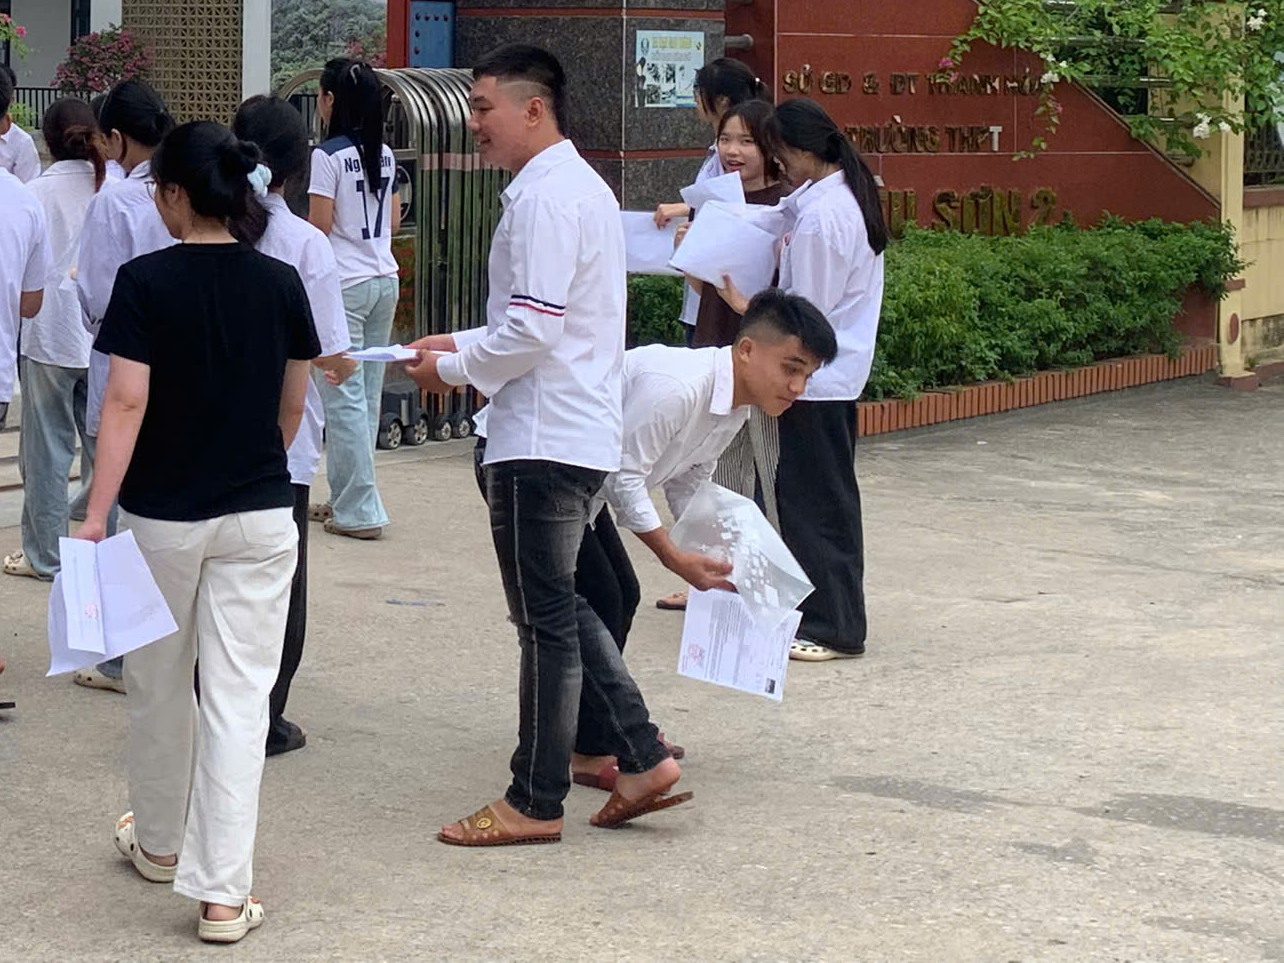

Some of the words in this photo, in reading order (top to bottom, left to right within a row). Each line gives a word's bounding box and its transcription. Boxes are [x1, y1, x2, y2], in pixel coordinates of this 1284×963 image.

[782, 63, 812, 94] SỞ
[820, 71, 852, 94] GD
[945, 125, 1003, 154] THPT
[931, 184, 1021, 237] SƠN
